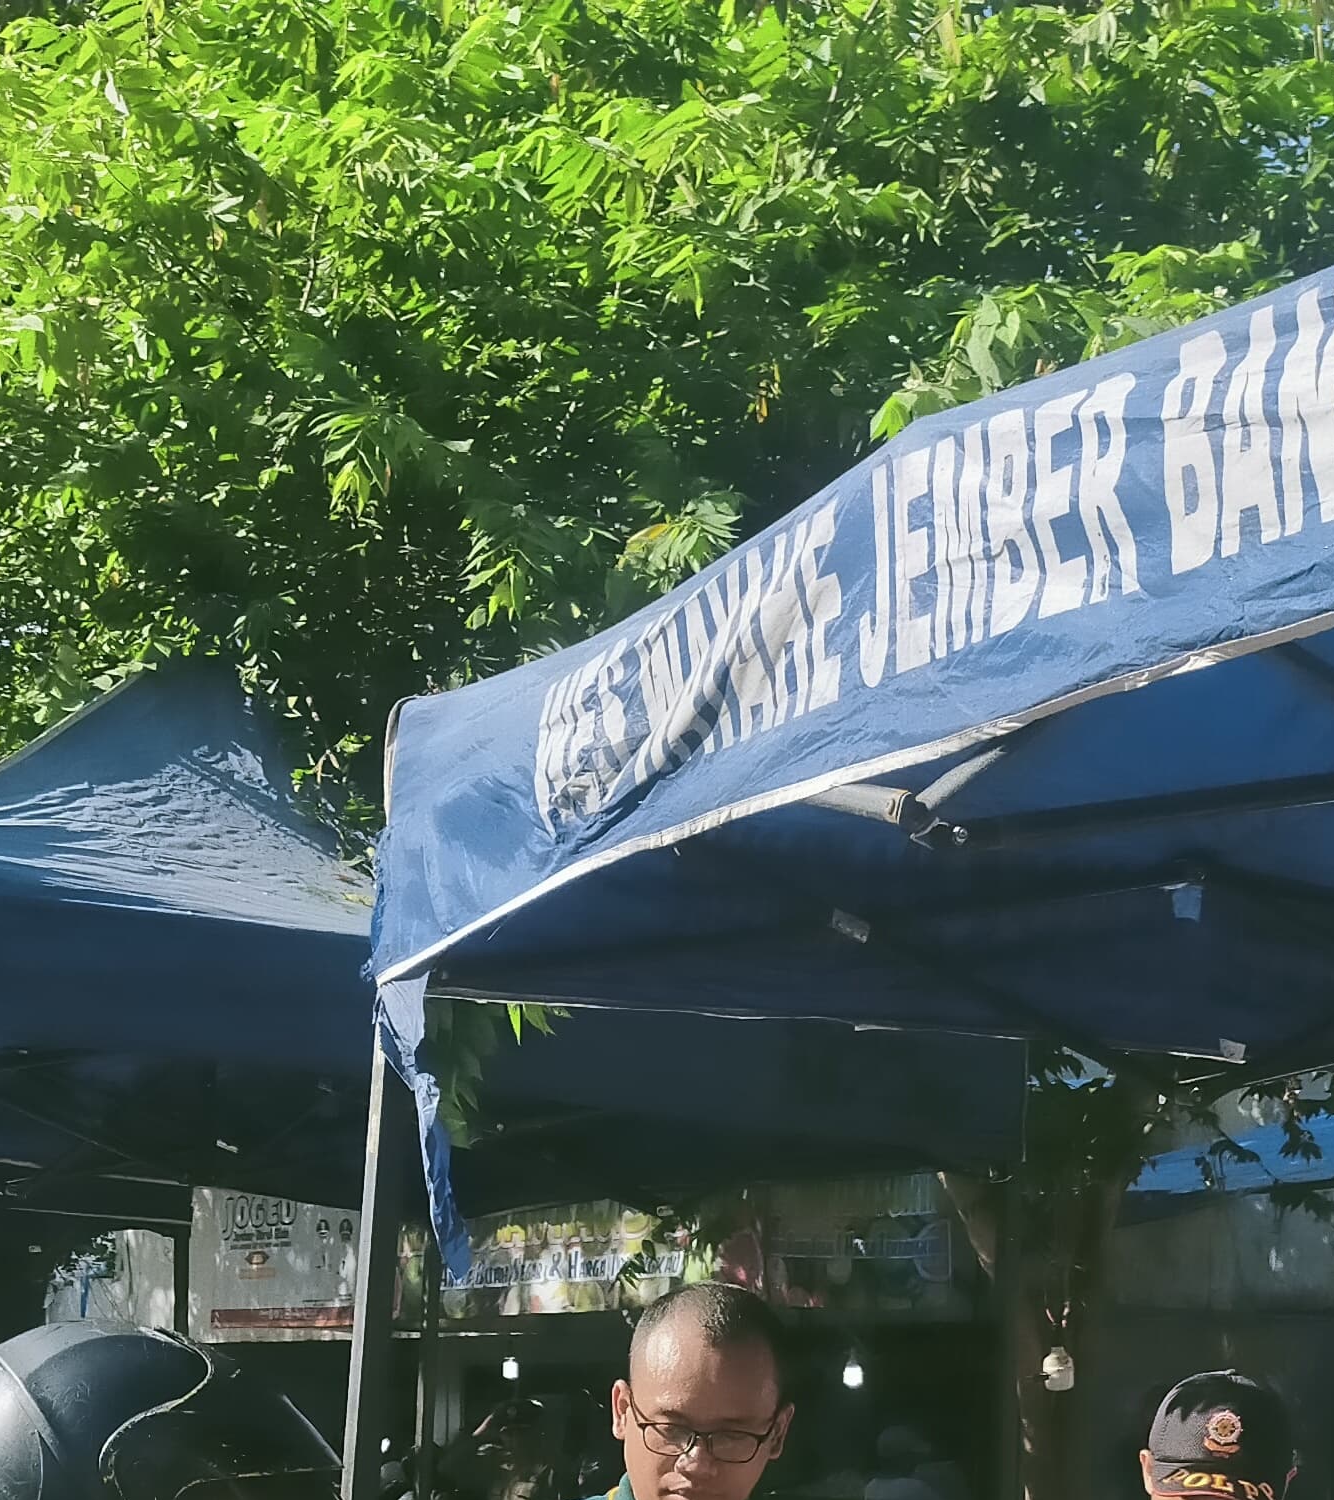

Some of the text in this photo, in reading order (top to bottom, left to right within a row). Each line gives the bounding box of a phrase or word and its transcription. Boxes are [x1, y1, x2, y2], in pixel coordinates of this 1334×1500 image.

[861, 373, 1143, 690] JEMBER
[549, 1251, 562, 1279] &
[1162, 1467, 1235, 1494] POL
